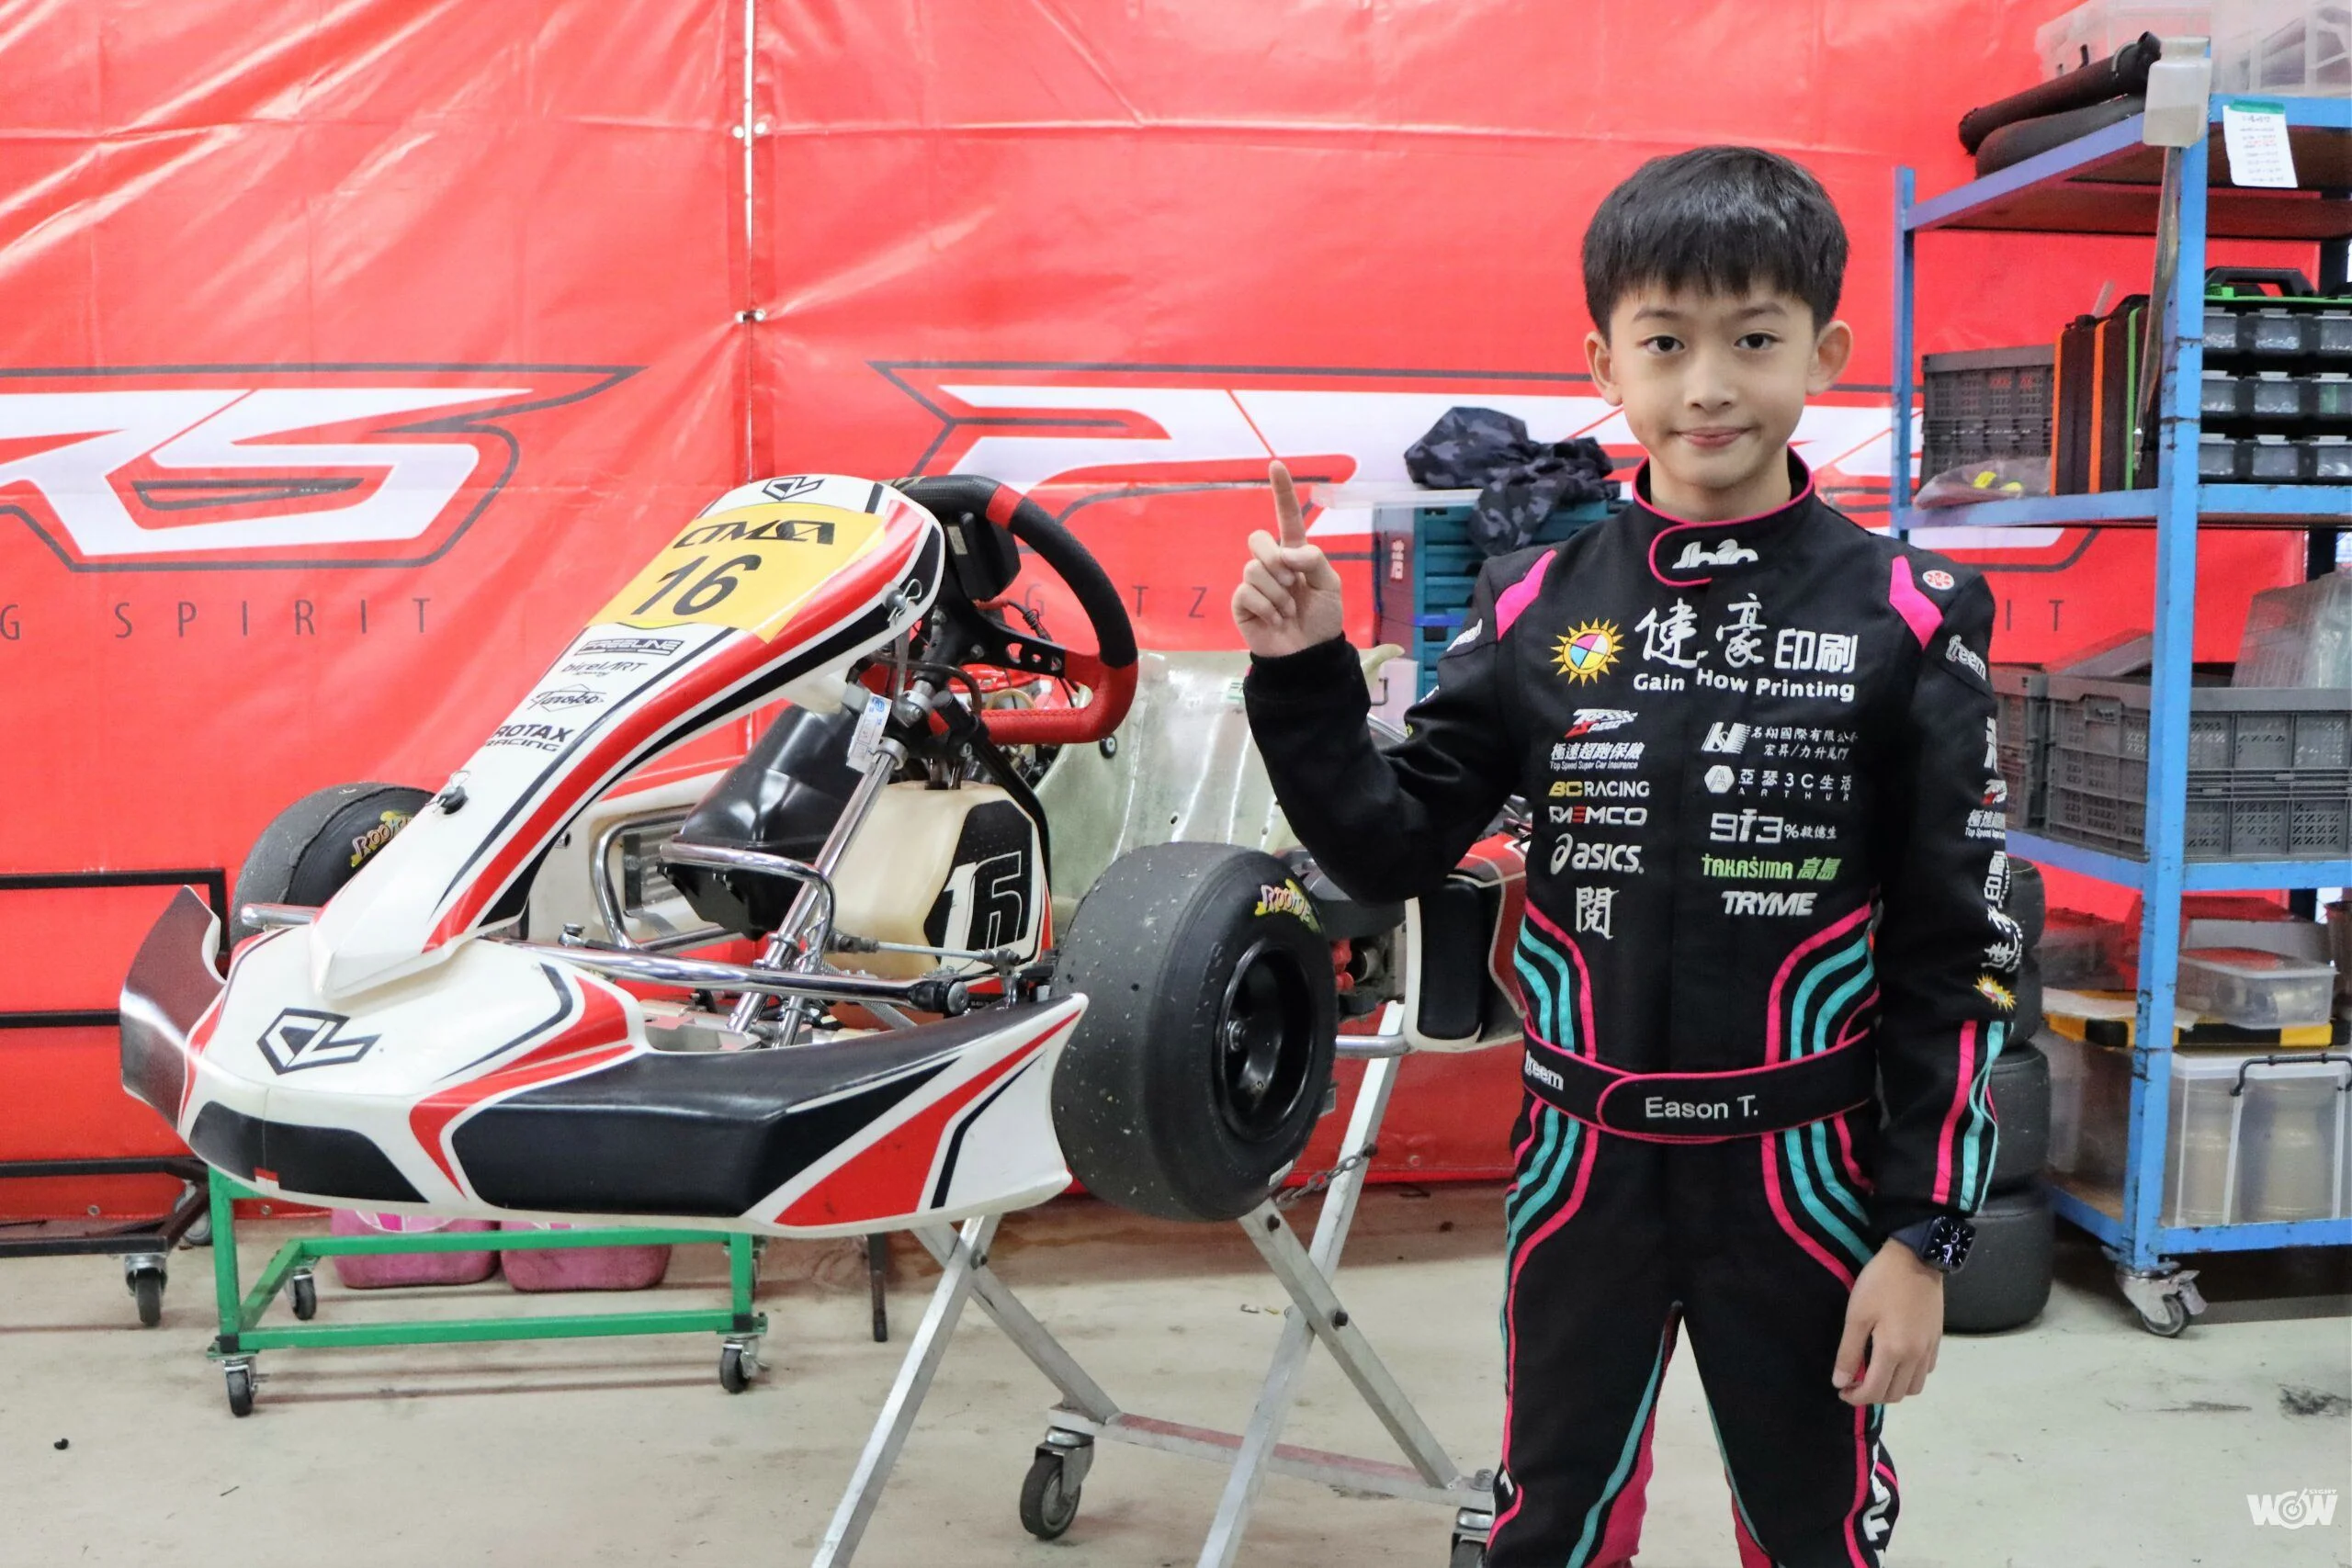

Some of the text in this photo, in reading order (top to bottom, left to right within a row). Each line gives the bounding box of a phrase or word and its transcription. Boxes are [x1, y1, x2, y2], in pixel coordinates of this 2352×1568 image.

[630, 553, 763, 617] 16
[115, 597, 432, 639] SPIRIT
[1634, 592, 1859, 675] 健豪印刷
[1633, 668, 1855, 703] Gain How Printing
[493, 724, 576, 743] ROTAX
[1550, 761, 1561, 772] Top
[1721, 890, 1818, 917] TRYME
[1645, 1095, 1758, 1120] Eason T.
